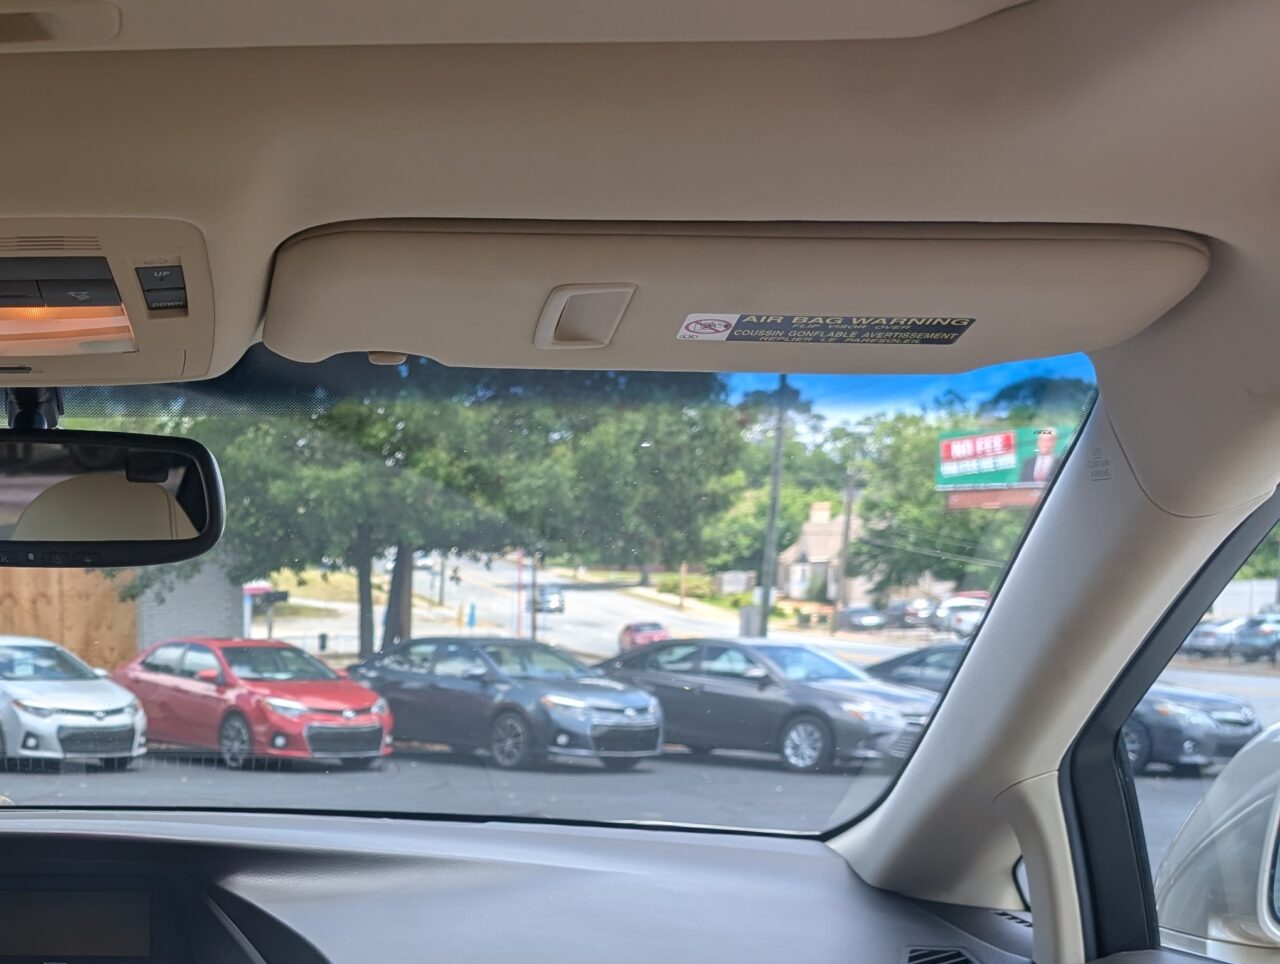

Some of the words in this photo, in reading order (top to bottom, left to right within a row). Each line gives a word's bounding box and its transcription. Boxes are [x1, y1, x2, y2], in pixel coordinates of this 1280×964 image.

[741, 315, 784, 323] AIR
[791, 315, 844, 325] BAG
[851, 316, 971, 326] WARNING
[733, 329, 785, 337] COUSSIN
[788, 330, 858, 338] GONFLABLE
[861, 331, 960, 340] AVERTISSEMENT
